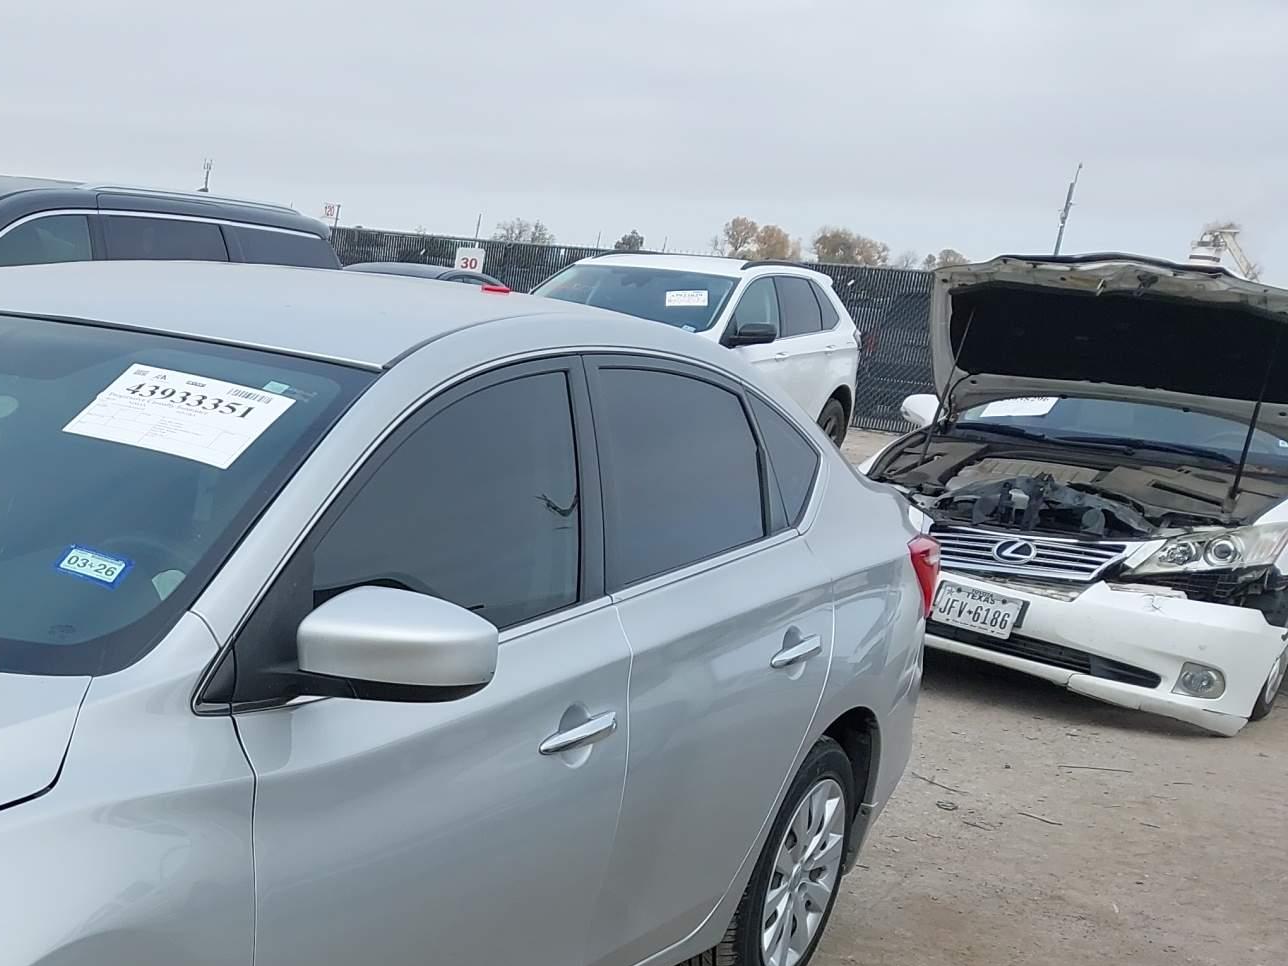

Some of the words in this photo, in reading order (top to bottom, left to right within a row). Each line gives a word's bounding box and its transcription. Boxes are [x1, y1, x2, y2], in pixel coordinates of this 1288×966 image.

[460, 256, 478, 270] 30
[126, 383, 254, 418] 43933351
[67, 555, 90, 568] 03
[93, 563, 118, 577] 26
[966, 591, 996, 605] TEXAS
